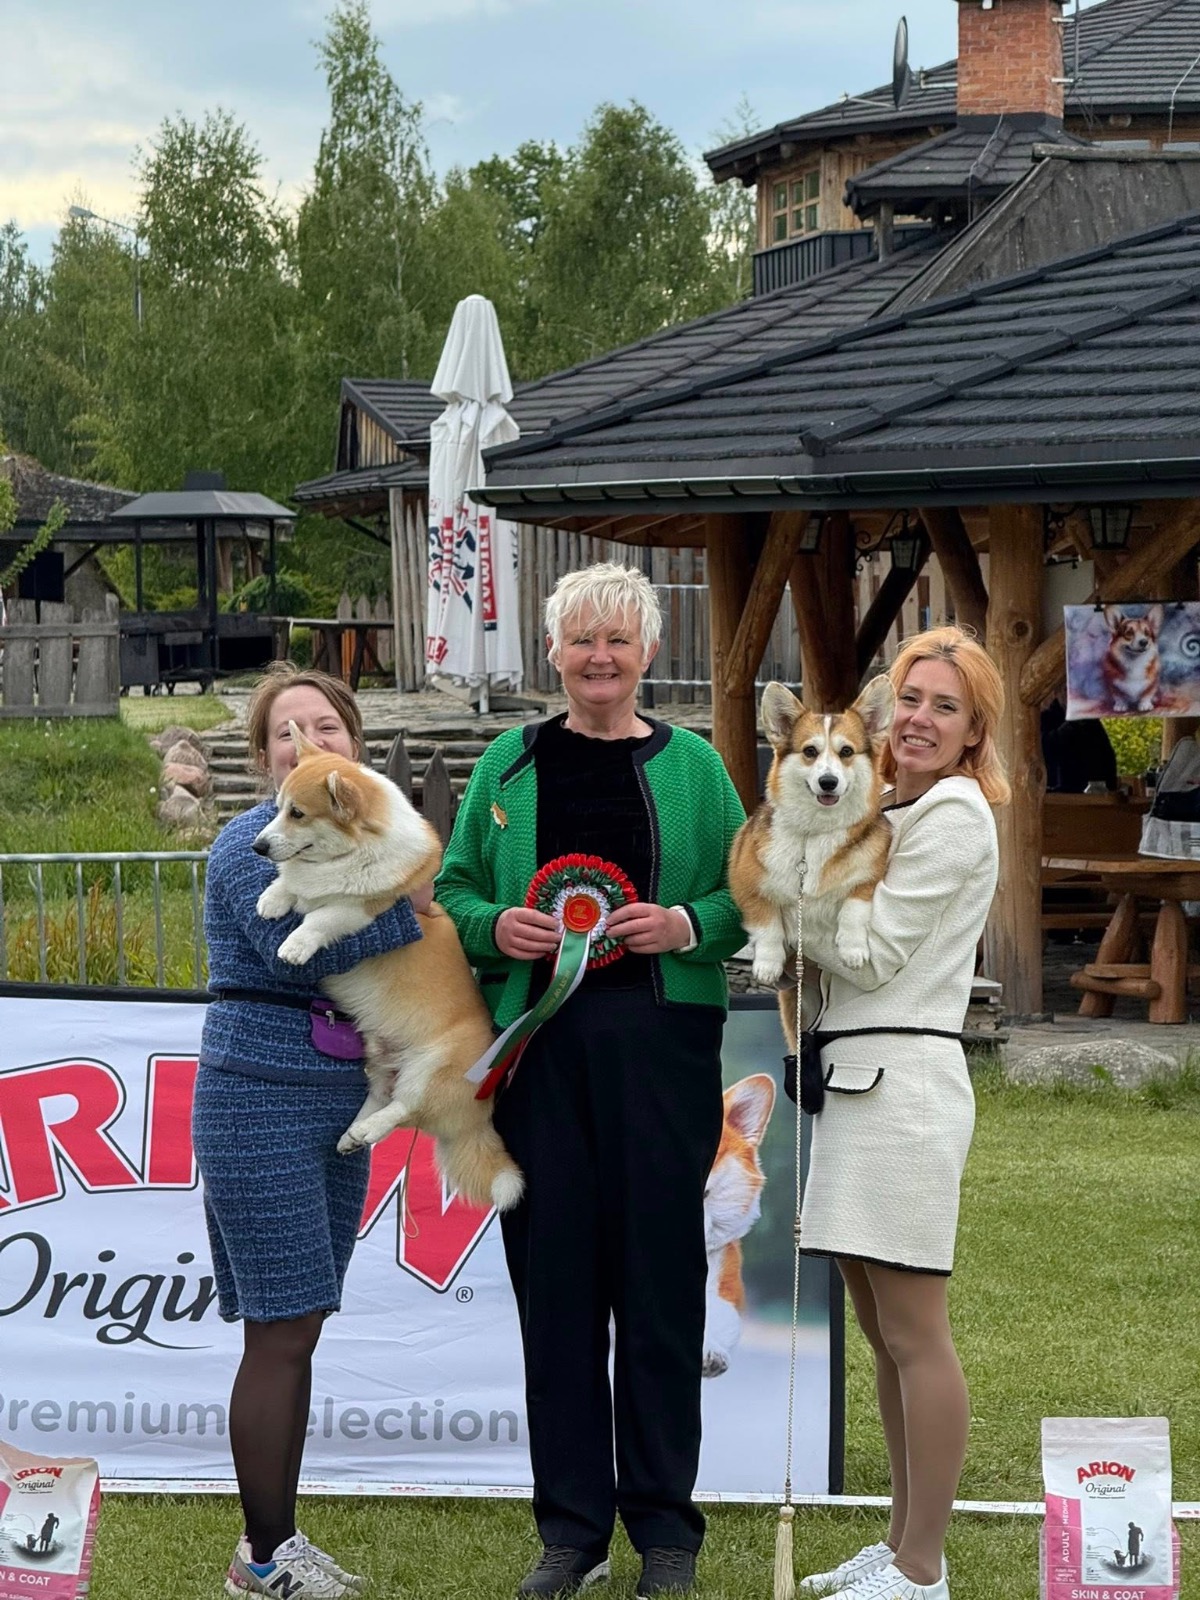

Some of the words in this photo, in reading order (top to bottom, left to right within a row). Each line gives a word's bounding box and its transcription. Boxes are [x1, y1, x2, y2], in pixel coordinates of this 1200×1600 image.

[0, 1053, 499, 1293] RIN
[0, 1391, 226, 1436] remium
[306, 1396, 518, 1442] lection
[1076, 1461, 1137, 1484] ARION
[1085, 1482, 1127, 1495] Original
[1061, 1531, 1070, 1563] ADULT
[19, 1574, 51, 1586] COAT
[1071, 1589, 1099, 1600] SKIN
[1102, 1590, 1110, 1600] &
[1114, 1590, 1146, 1600] COAT
